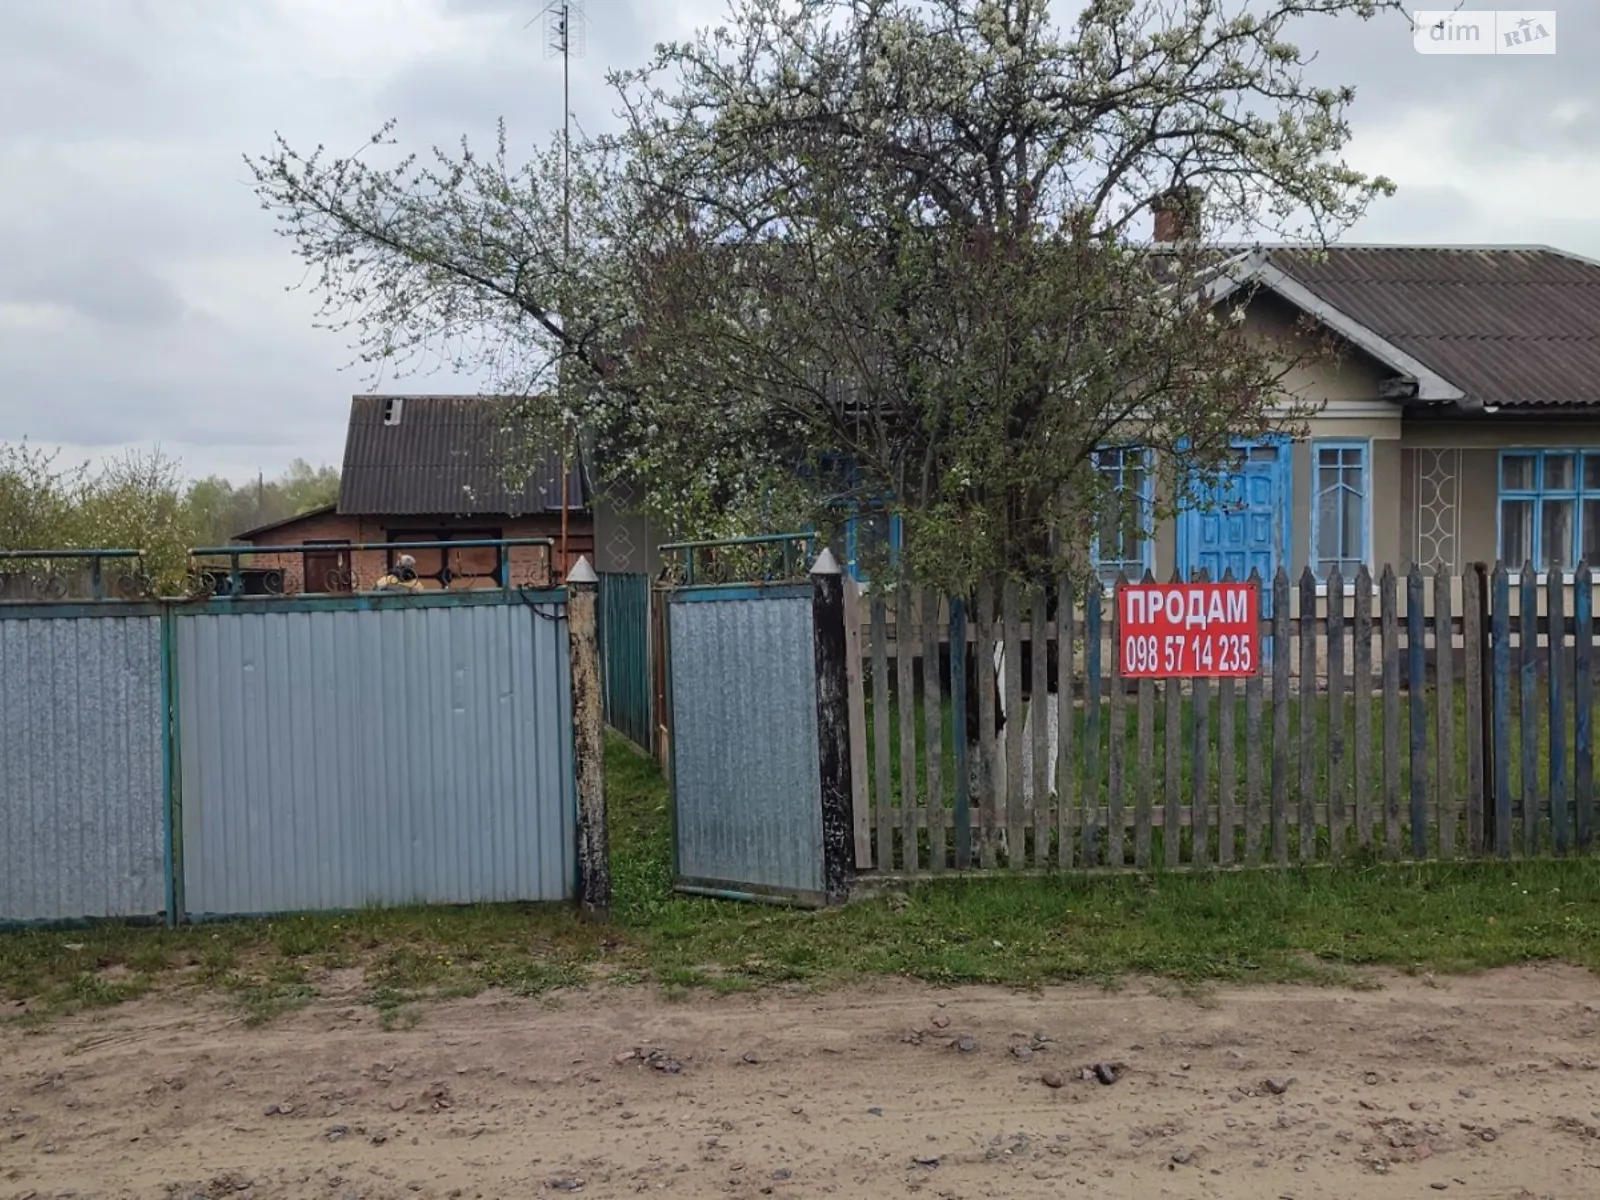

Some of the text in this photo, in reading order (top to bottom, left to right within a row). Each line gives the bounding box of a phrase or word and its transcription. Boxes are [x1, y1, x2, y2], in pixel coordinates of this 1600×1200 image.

[1126, 589, 1248, 631] ПРОДАМ
[1126, 634, 1251, 673] 098 57 14 235
